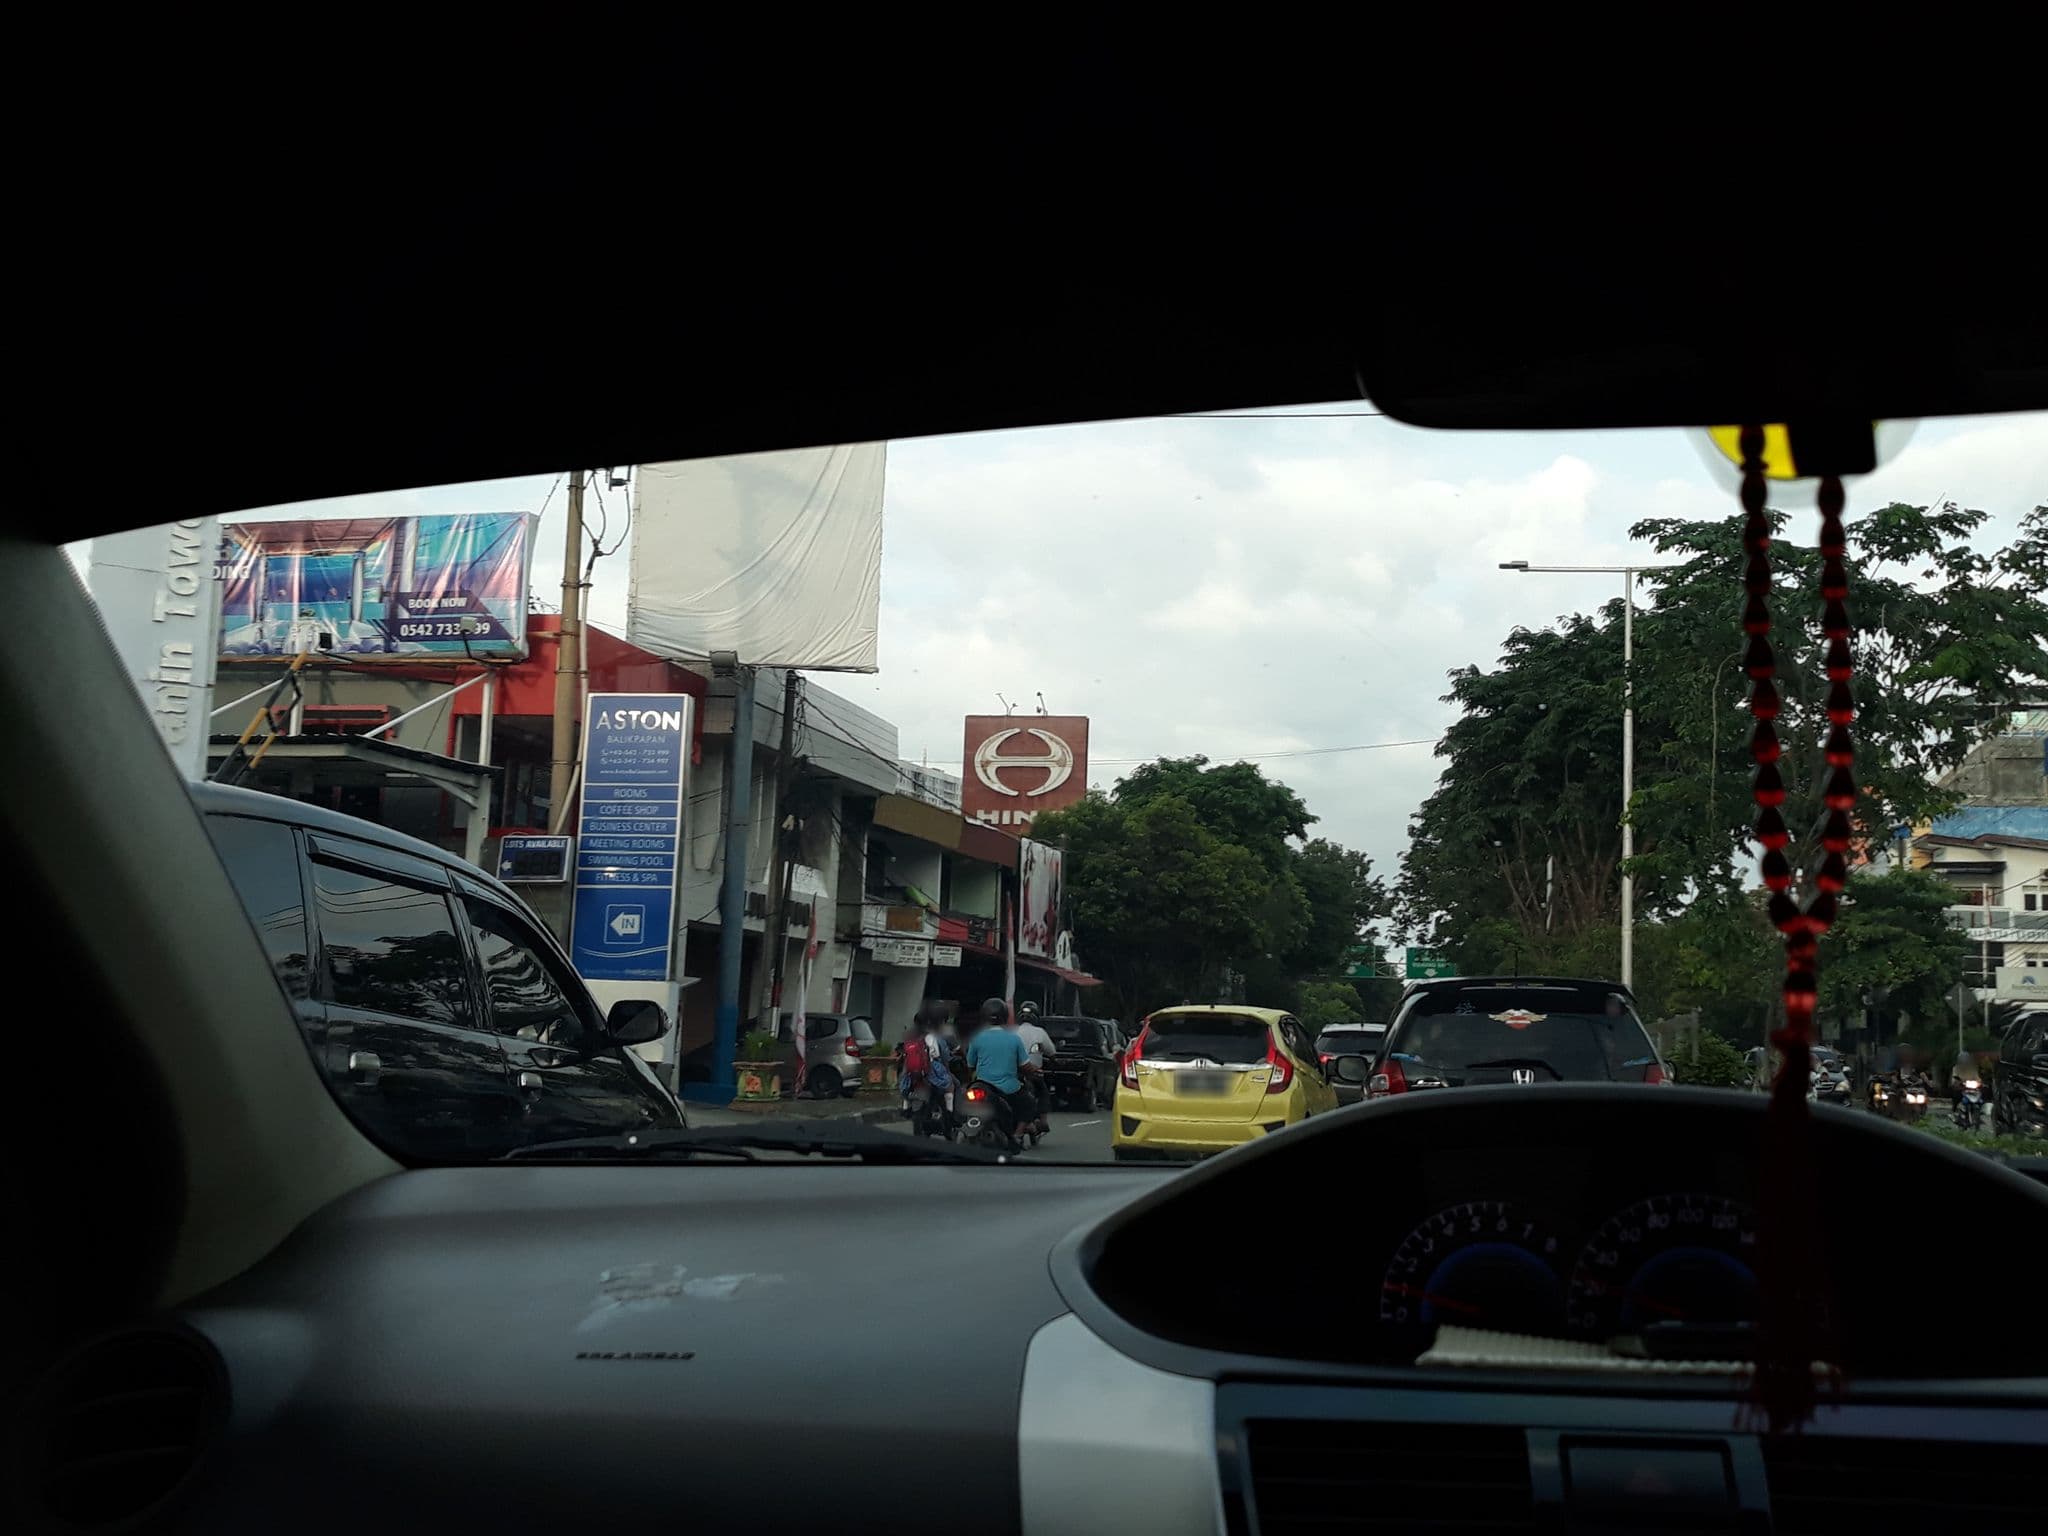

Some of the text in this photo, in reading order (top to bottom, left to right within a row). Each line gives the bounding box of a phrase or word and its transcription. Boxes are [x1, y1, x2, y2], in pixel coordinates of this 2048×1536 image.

[408, 597, 468, 609] BOOK NOW
[400, 623, 433, 636] 0542
[595, 710, 681, 731] ASTON
[613, 788, 648, 798] ROOMS
[600, 805, 659, 815] COFFEE SHOP
[976, 809, 1065, 825] HIN
[589, 822, 668, 832] BUSINESS CENTER
[525, 839, 566, 849] AVAILABLE
[589, 838, 666, 849] MEETING ROOMS
[587, 855, 665, 866] SWIMMING POOL
[641, 873, 658, 882] SPA
[621, 918, 635, 929] IN
[1647, 1212, 1672, 1230] 80
